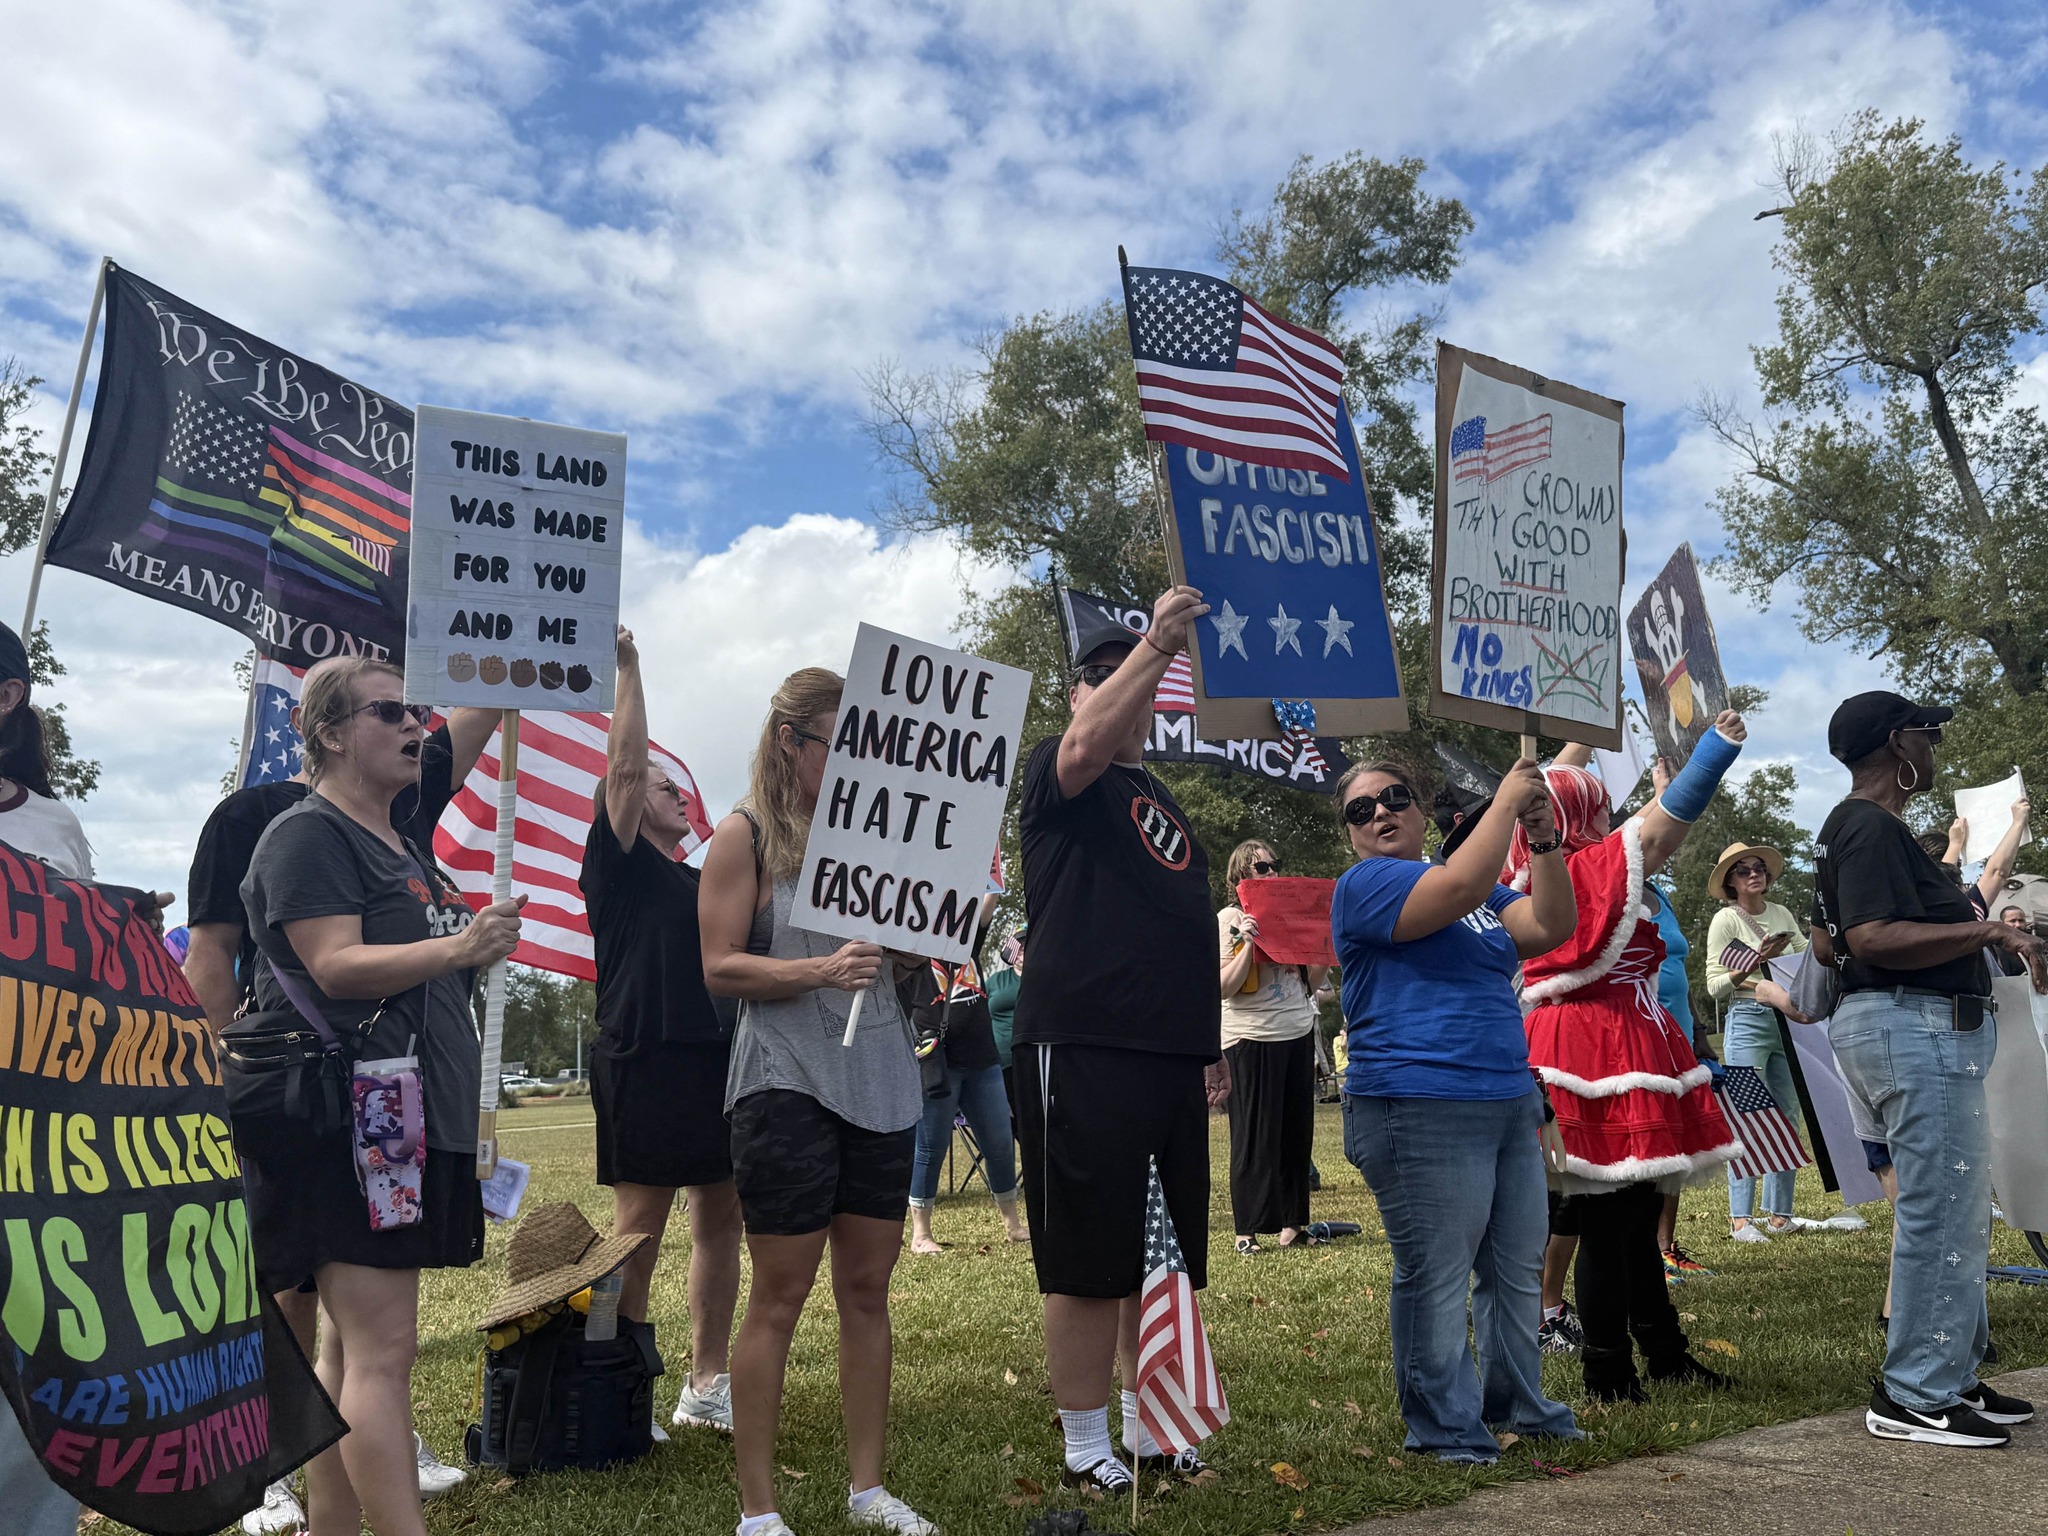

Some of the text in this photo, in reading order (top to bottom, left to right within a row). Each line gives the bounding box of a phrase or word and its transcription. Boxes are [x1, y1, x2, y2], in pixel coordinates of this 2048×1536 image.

[318, 382, 414, 478] Peo
[450, 440, 608, 488] THIS LAND
[450, 494, 608, 543] WAS MADE
[1453, 496, 1591, 557] THY GOOD
[1523, 470, 1615, 525] CROWN
[1199, 498, 1370, 568] FASCISM
[105, 541, 246, 614] MEANS
[454, 552, 586, 594] FOR YOU
[1494, 550, 1566, 591] WITH
[448, 609, 578, 645] AND ME
[1449, 576, 1618, 640] BROTHERHOOD
[1451, 624, 1503, 668] NO
[881, 644, 994, 720] LOVE
[1460, 664, 1533, 710] KINGS
[827, 776, 957, 851] HATE
[811, 856, 979, 946] FASCISM
[48, 1112, 110, 1194] IS
[114, 1112, 242, 1189] ILLEG
[122, 1198, 261, 1348] LOV
[30, 1328, 265, 1426] ARE HUMAN RIGHT
